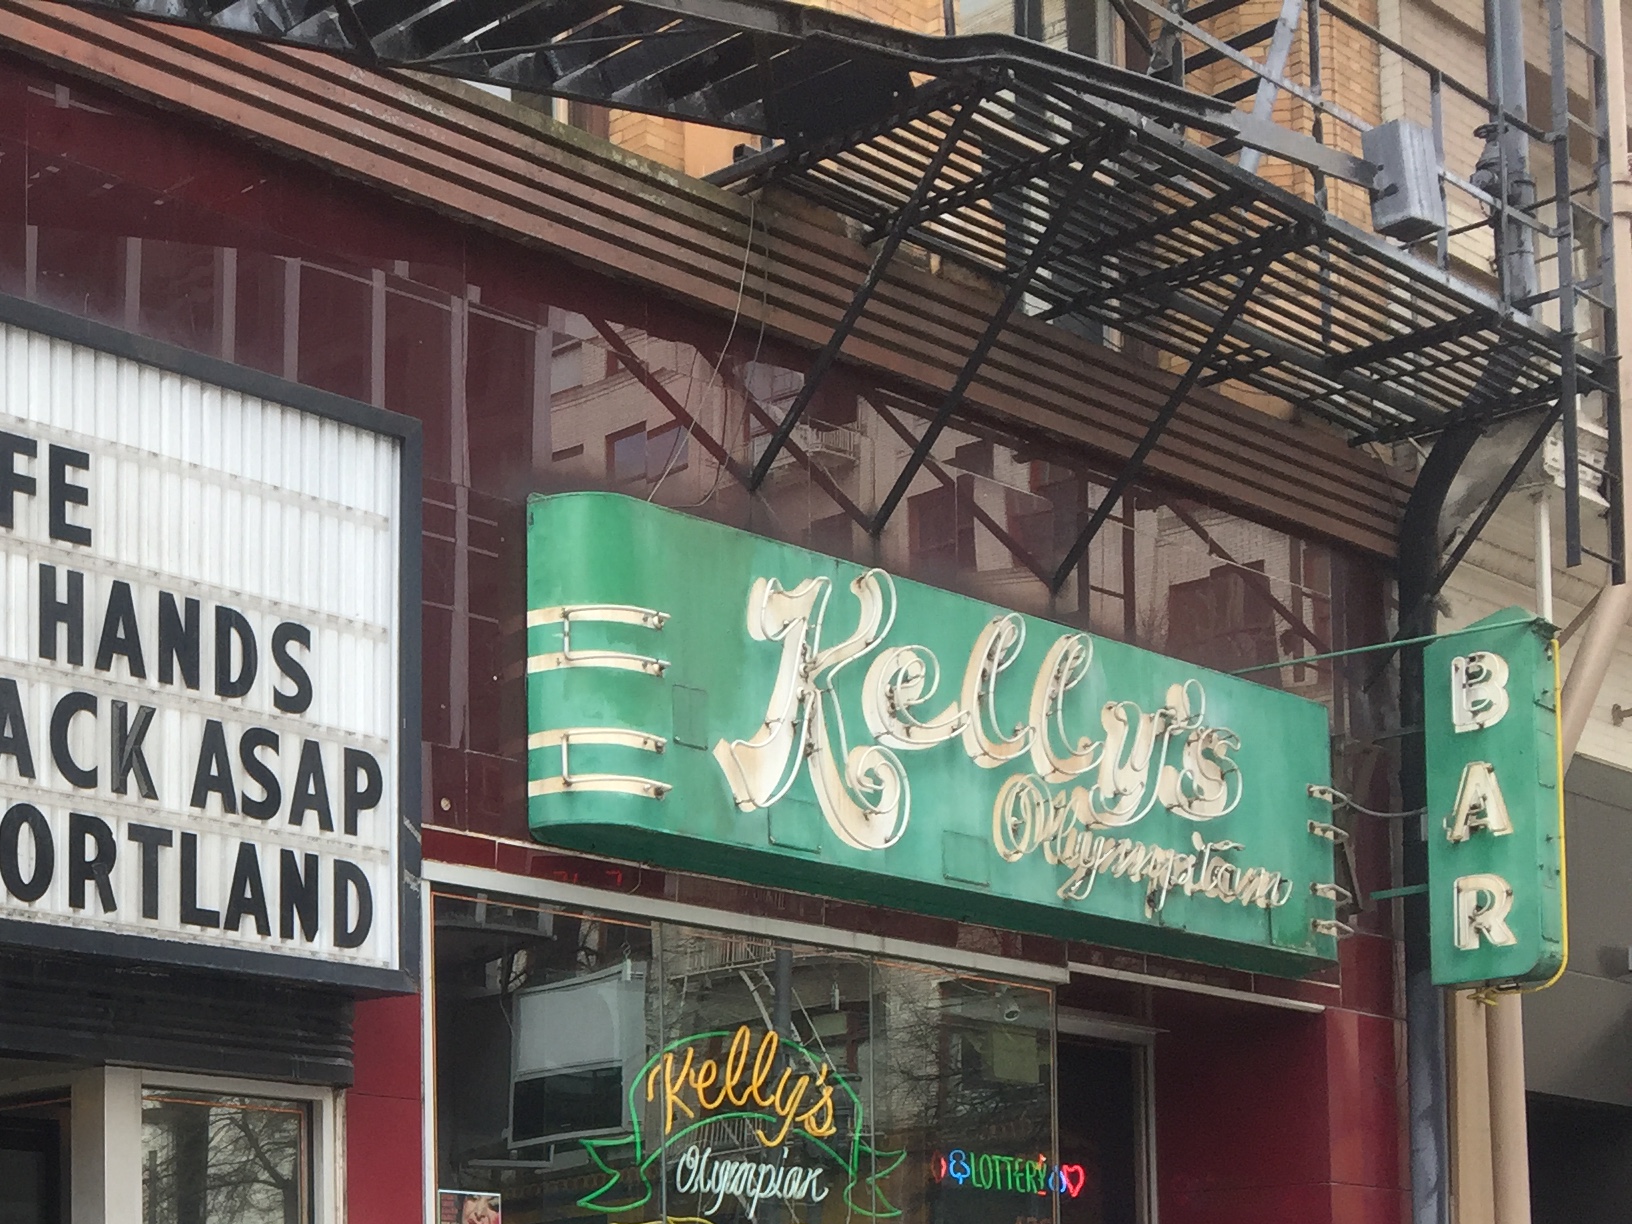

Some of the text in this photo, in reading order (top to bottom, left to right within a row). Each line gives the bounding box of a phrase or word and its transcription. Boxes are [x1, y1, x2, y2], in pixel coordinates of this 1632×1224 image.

[38, 563, 314, 714] HANDS
[713, 567, 1243, 851] Kelly's
[189, 718, 384, 837] ASAP
[1443, 651, 1517, 950] BAR
[647, 1025, 837, 1148] Kelly's
[675, 1144, 829, 1219] Olympian
[969, 1152, 1047, 1194] LOTTERY
